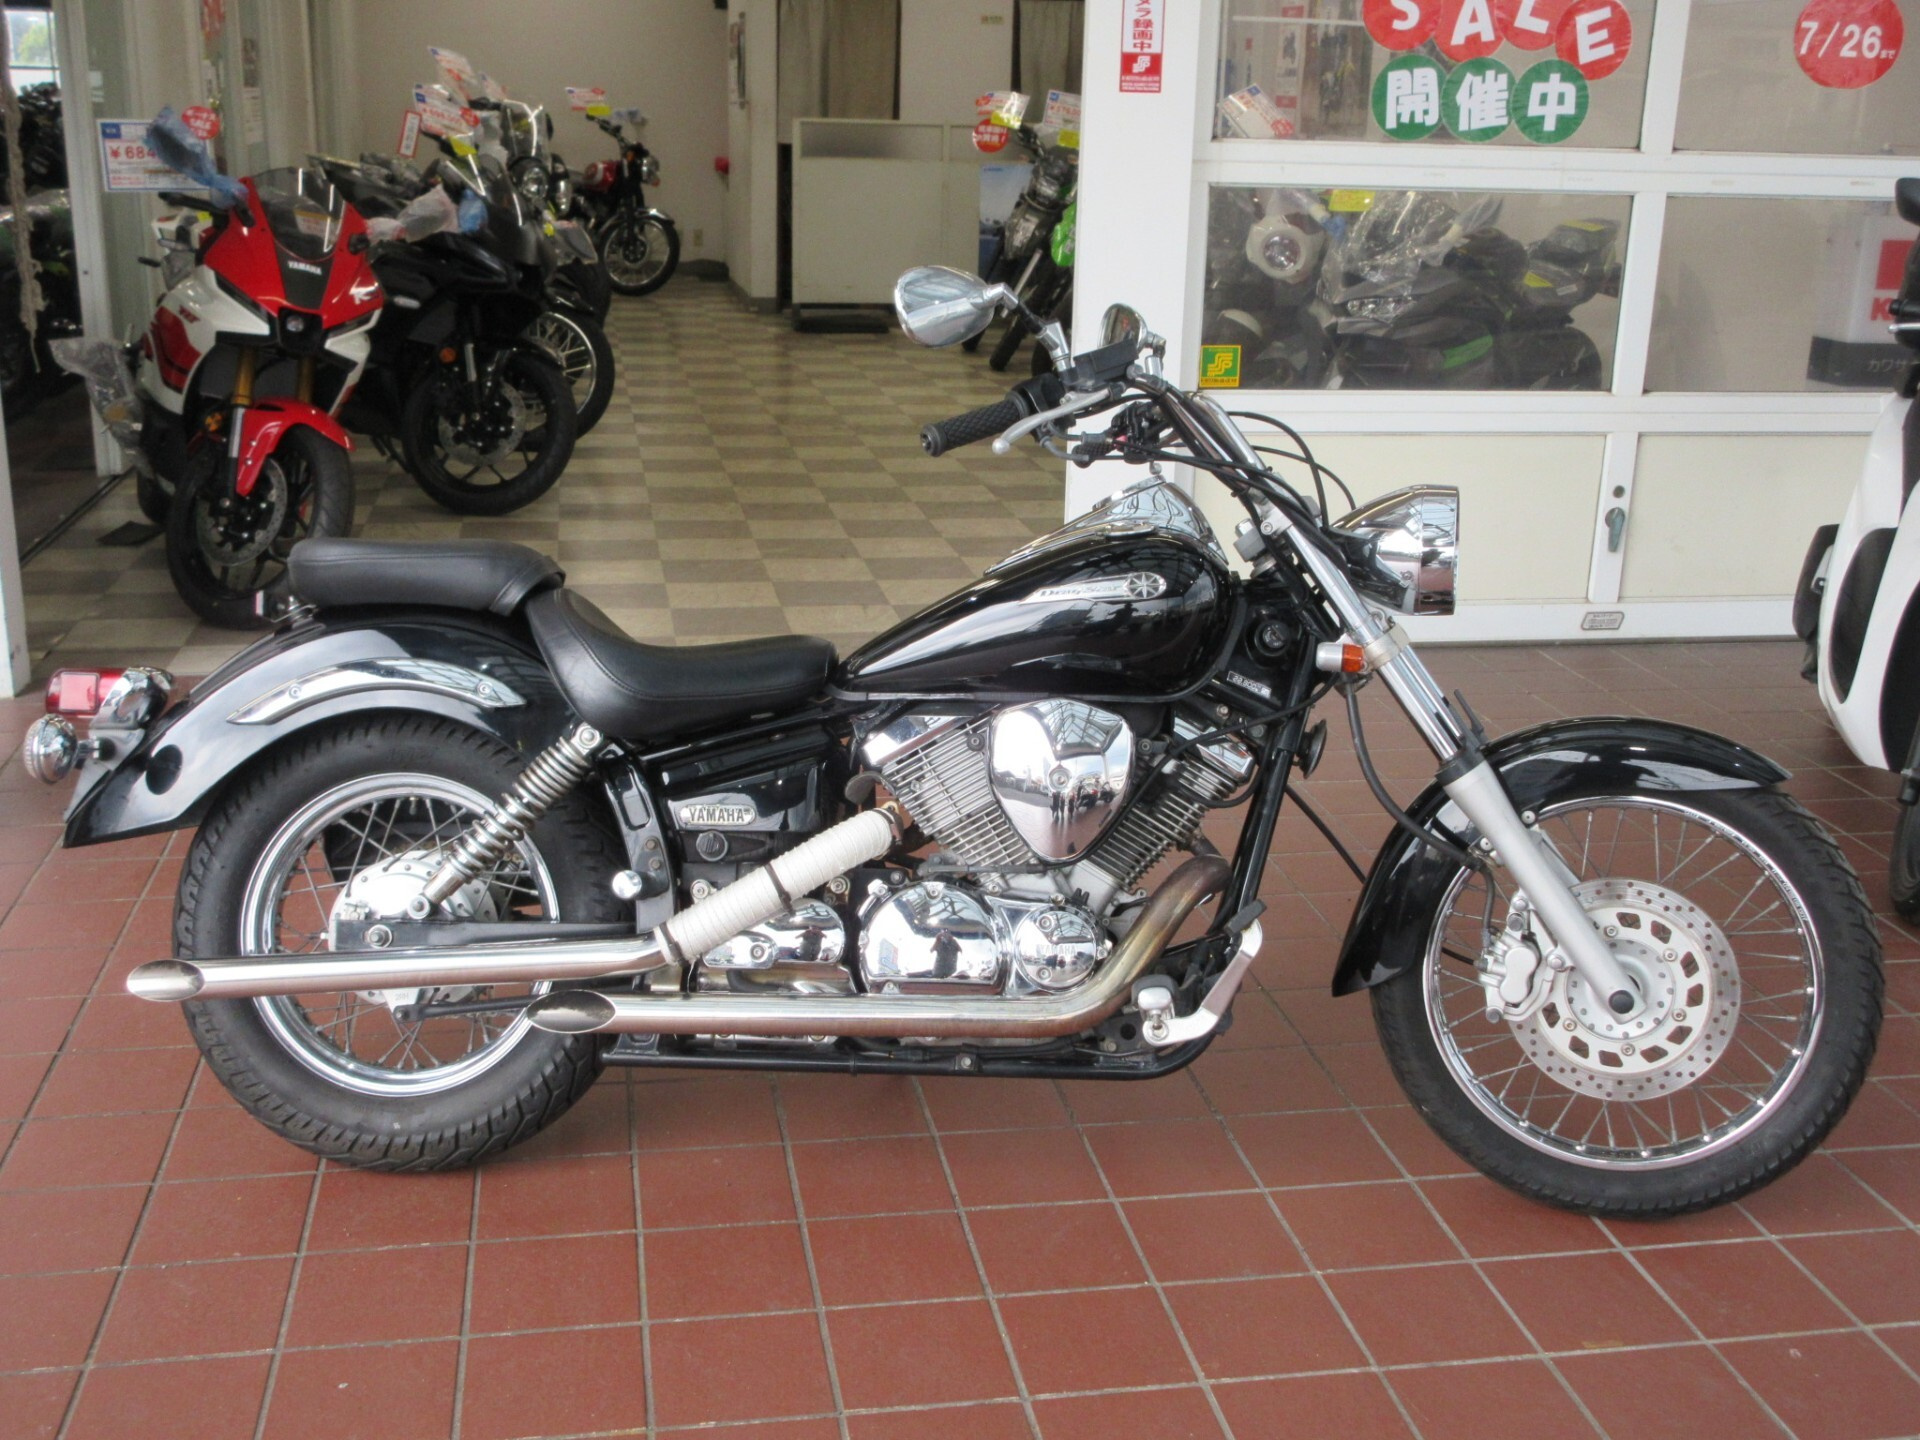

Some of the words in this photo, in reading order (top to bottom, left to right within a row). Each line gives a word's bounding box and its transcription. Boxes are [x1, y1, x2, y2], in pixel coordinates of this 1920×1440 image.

[1391, 0, 1615, 65] SALE
[1385, 67, 1577, 132] 開催中
[287, 260, 322, 275] YAMAHA
[689, 807, 745, 822] YAMAHA
